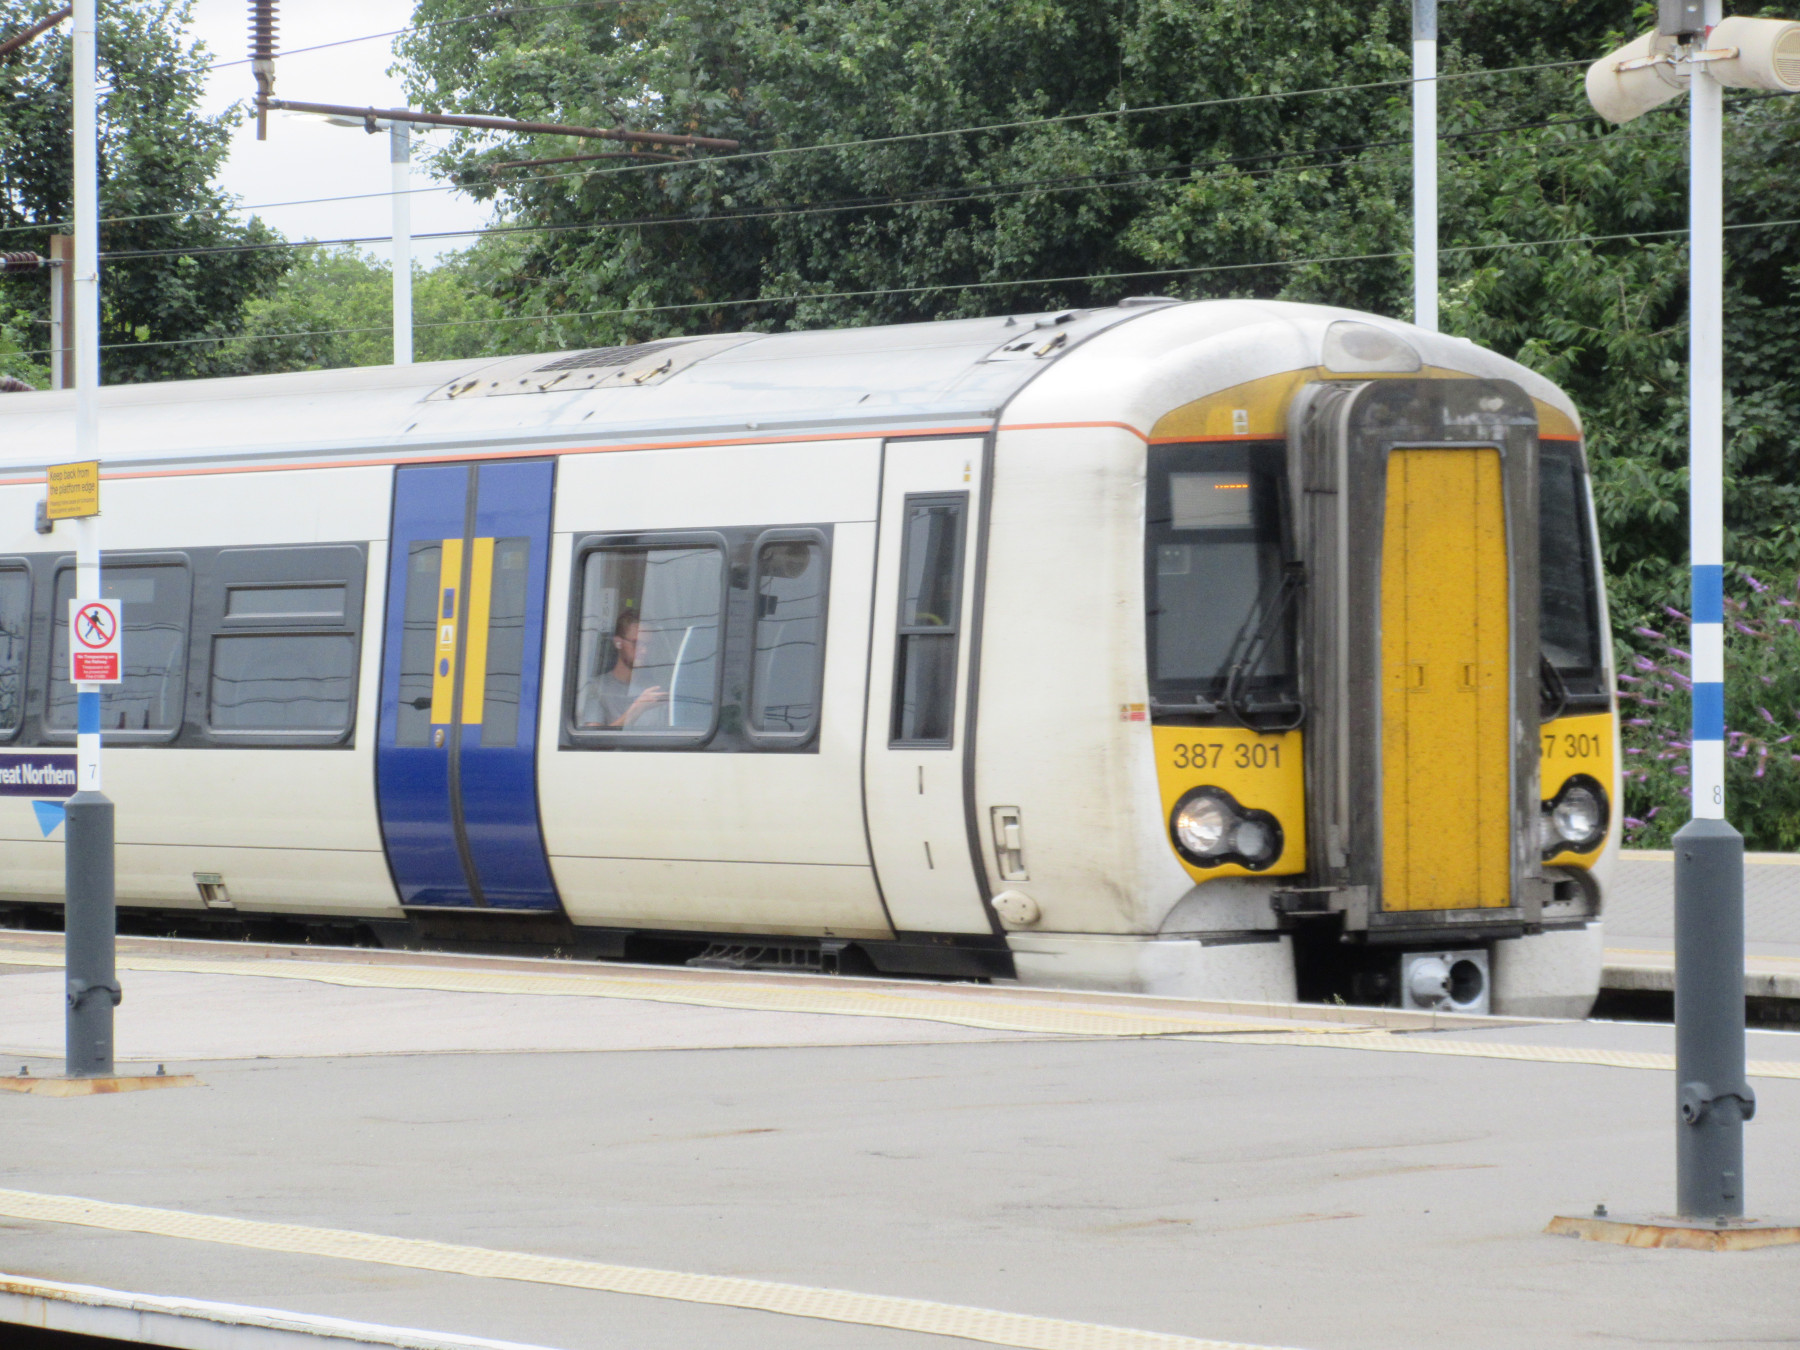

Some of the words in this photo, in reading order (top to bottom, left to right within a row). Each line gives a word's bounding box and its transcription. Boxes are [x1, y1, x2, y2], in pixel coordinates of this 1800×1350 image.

[50, 470, 63, 482] Keep
[63, 468, 76, 480] back
[77, 467, 90, 478] from
[50, 484, 58, 495] the
[59, 482, 80, 495] platform
[82, 481, 95, 493] edge
[1564, 733, 1600, 758] 301
[1173, 743, 1224, 768] 387
[1234, 743, 1280, 768] 301
[0, 765, 21, 784] reat
[22, 763, 76, 784] Northern
[88, 764, 96, 779] 7
[1713, 785, 1721, 804] 8
